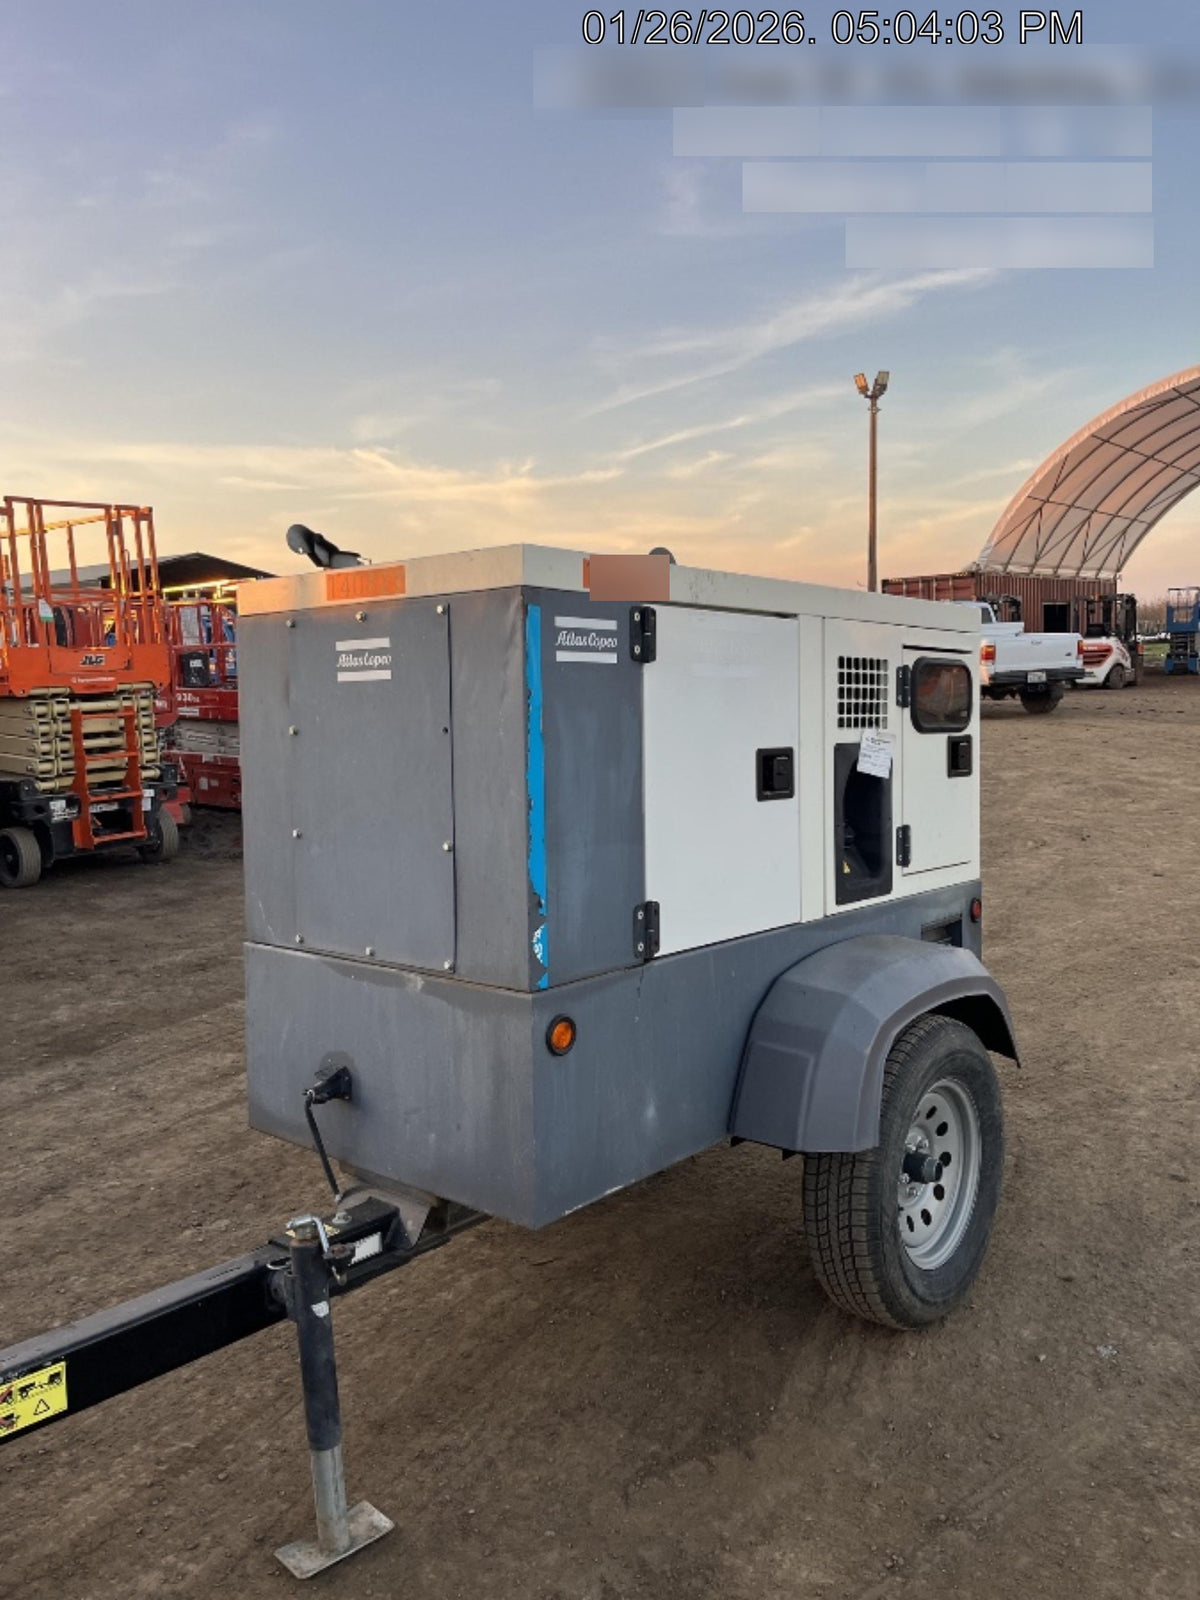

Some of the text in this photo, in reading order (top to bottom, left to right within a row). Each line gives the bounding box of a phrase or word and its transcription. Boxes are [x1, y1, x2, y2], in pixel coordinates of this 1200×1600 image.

[555, 630, 618, 651] Atlas Copco
[80, 654, 105, 667] JLG
[336, 653, 363, 667] Atlas
